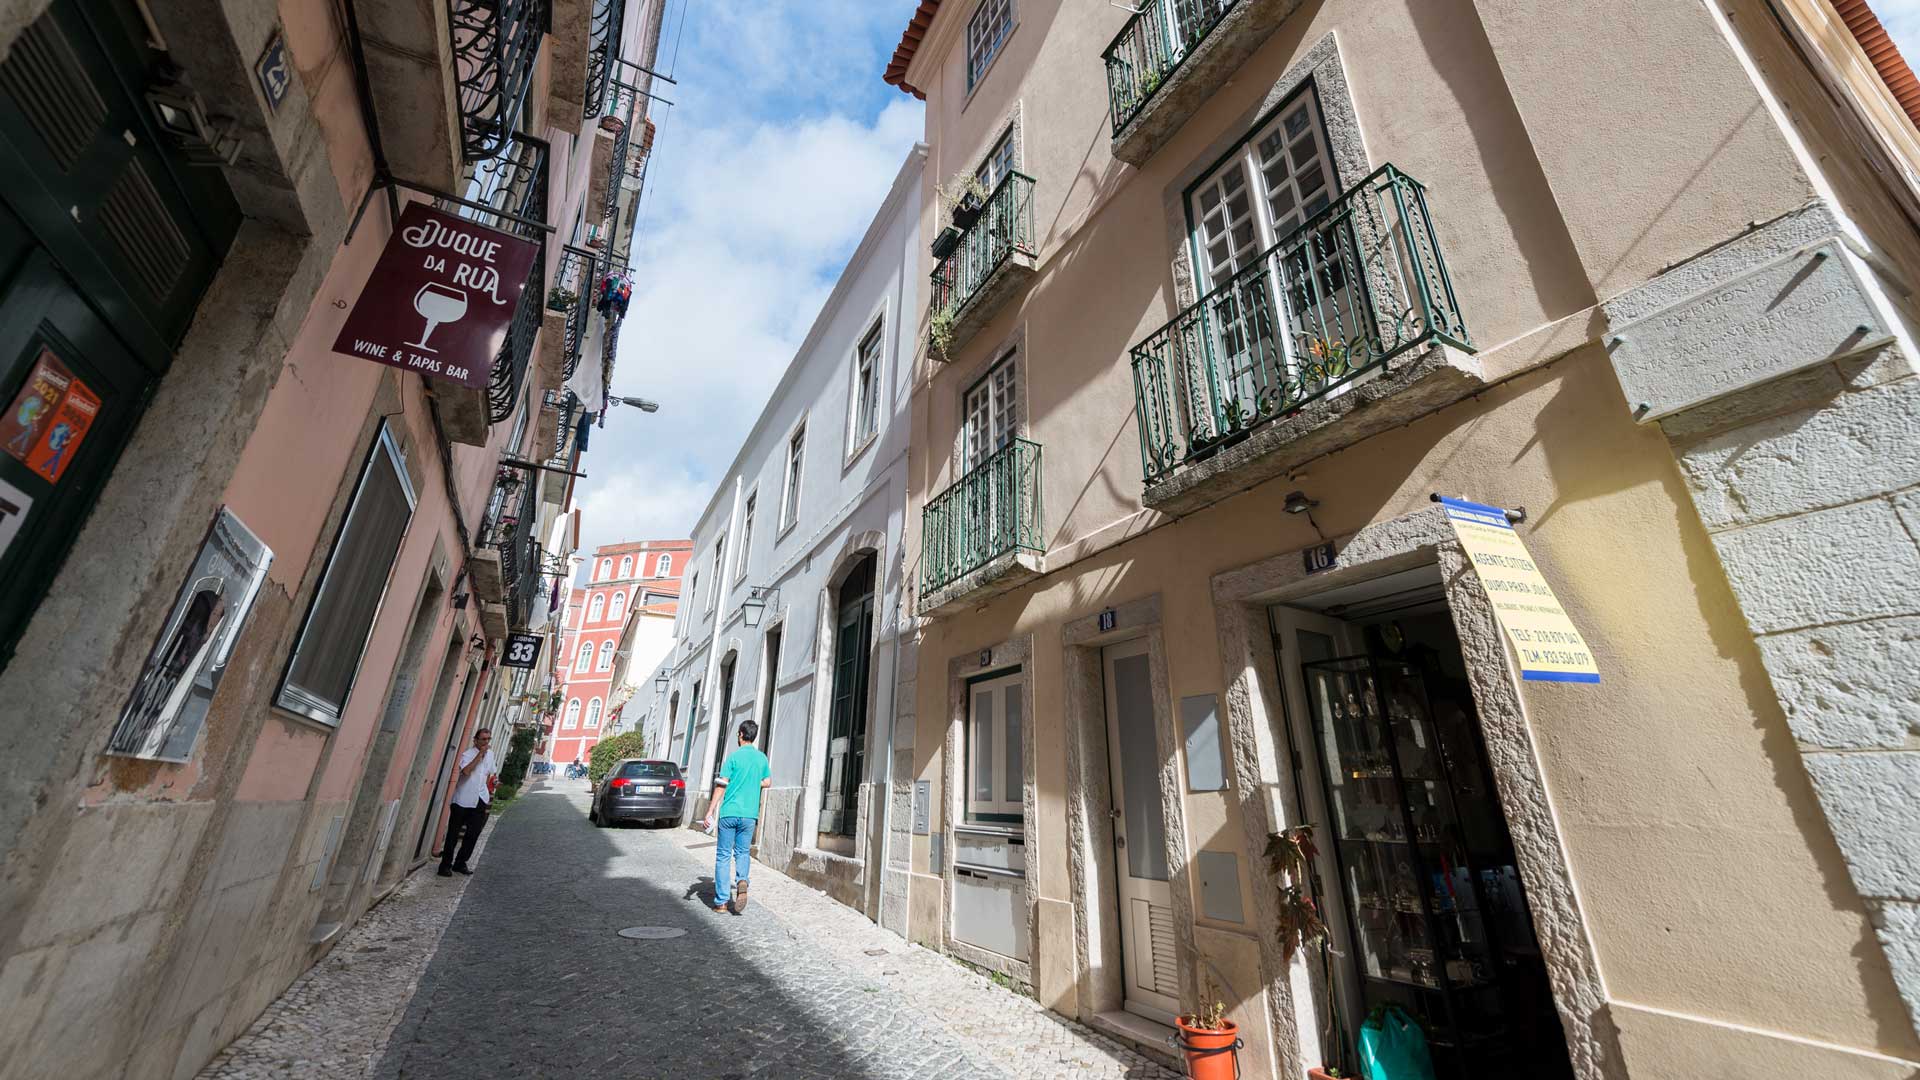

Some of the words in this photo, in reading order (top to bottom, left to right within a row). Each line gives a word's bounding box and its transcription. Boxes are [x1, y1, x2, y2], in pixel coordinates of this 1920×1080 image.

[402, 219, 502, 263] DUQUE
[423, 255, 446, 273] DA
[452, 263, 507, 305] RUA
[354, 339, 388, 358] WINE
[392, 350, 402, 362] &
[408, 353, 442, 372] TAPAS
[446, 365, 469, 380] BAR
[1711, 355, 1781, 384] LISBOA
[32, 378, 59, 406] 2021
[1311, 546, 1329, 570] 16
[1473, 552, 1506, 568] AGENTE
[1503, 556, 1537, 571] CITIZEN
[1484, 579, 1508, 591] OURO
[1507, 580, 1531, 593] PRATA
[1103, 612, 1113, 630] 18
[1534, 630, 1551, 643] 218
[1551, 630, 1566, 643] 879
[509, 642, 535, 662] 33
[1542, 650, 1558, 664] 933
[1558, 651, 1575, 665] 536
[1575, 652, 1591, 665] 079
